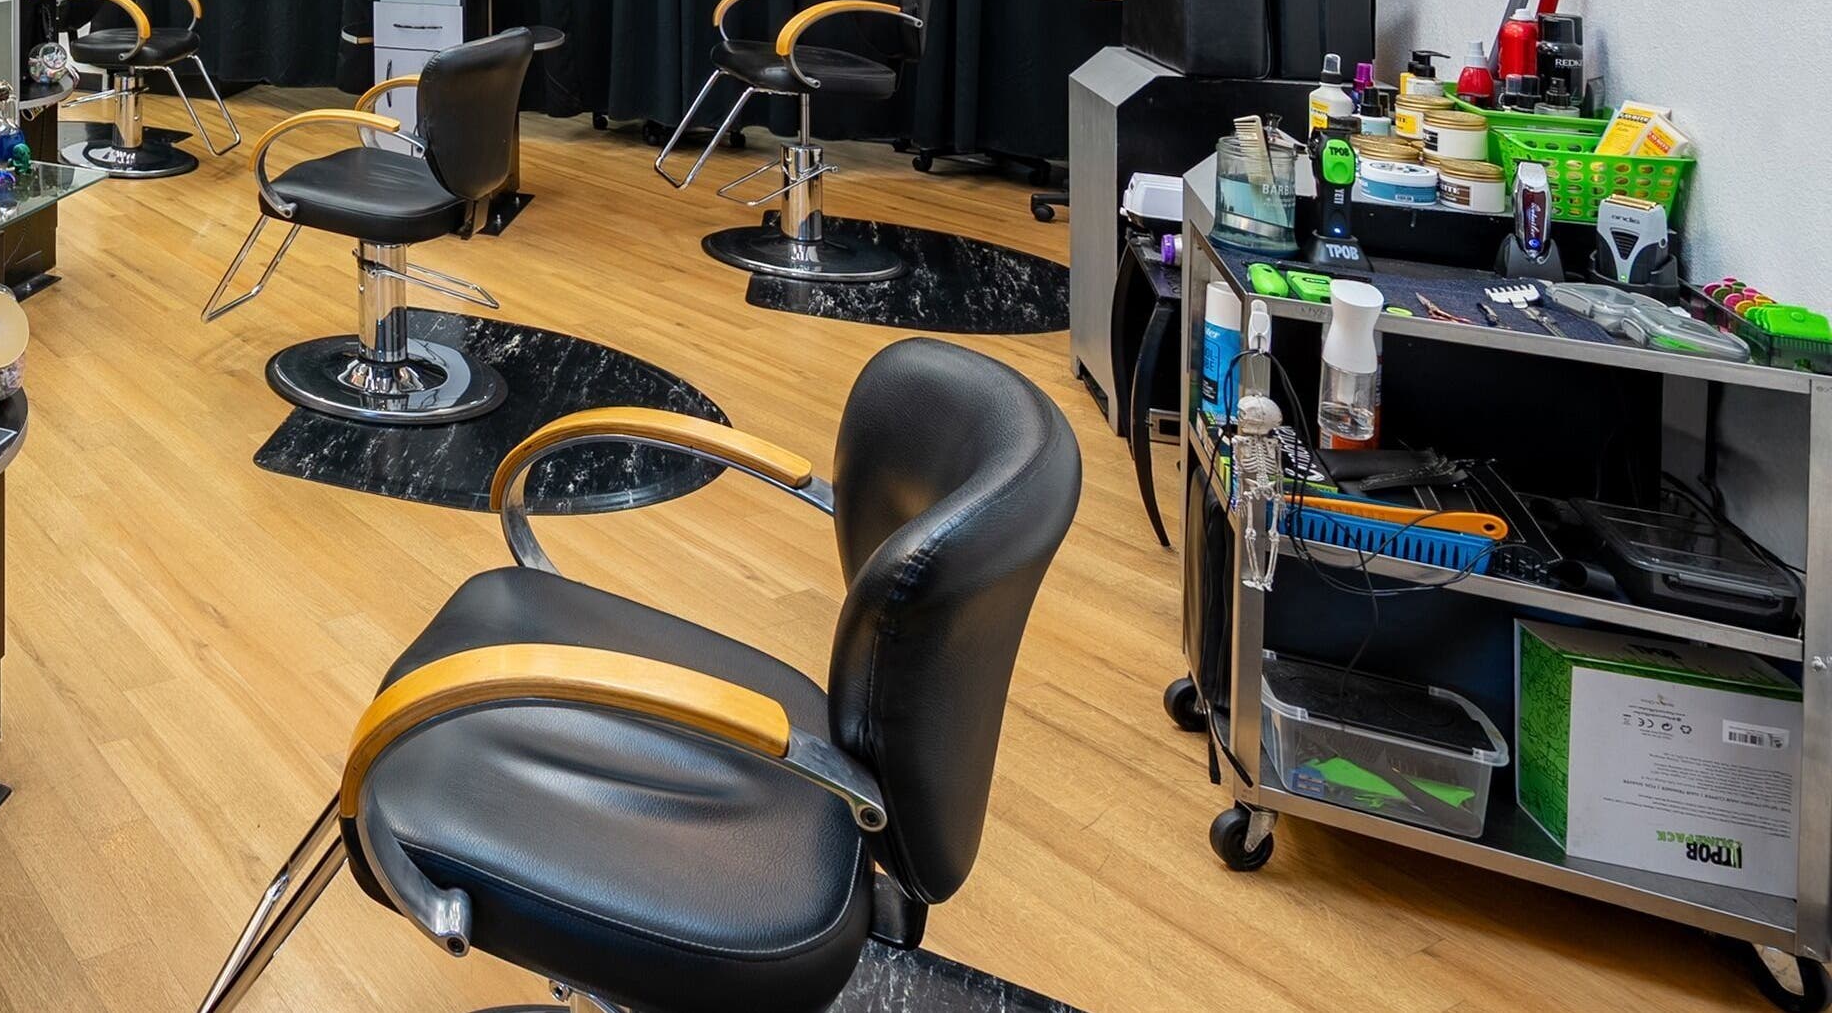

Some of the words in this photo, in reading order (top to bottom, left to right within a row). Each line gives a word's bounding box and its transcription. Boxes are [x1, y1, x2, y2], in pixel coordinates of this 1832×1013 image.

[1555, 58, 1583, 67] REDK
[1328, 146, 1350, 157] TPOB
[1334, 188, 1345, 205] YETI
[1326, 243, 1360, 260] TPOB
